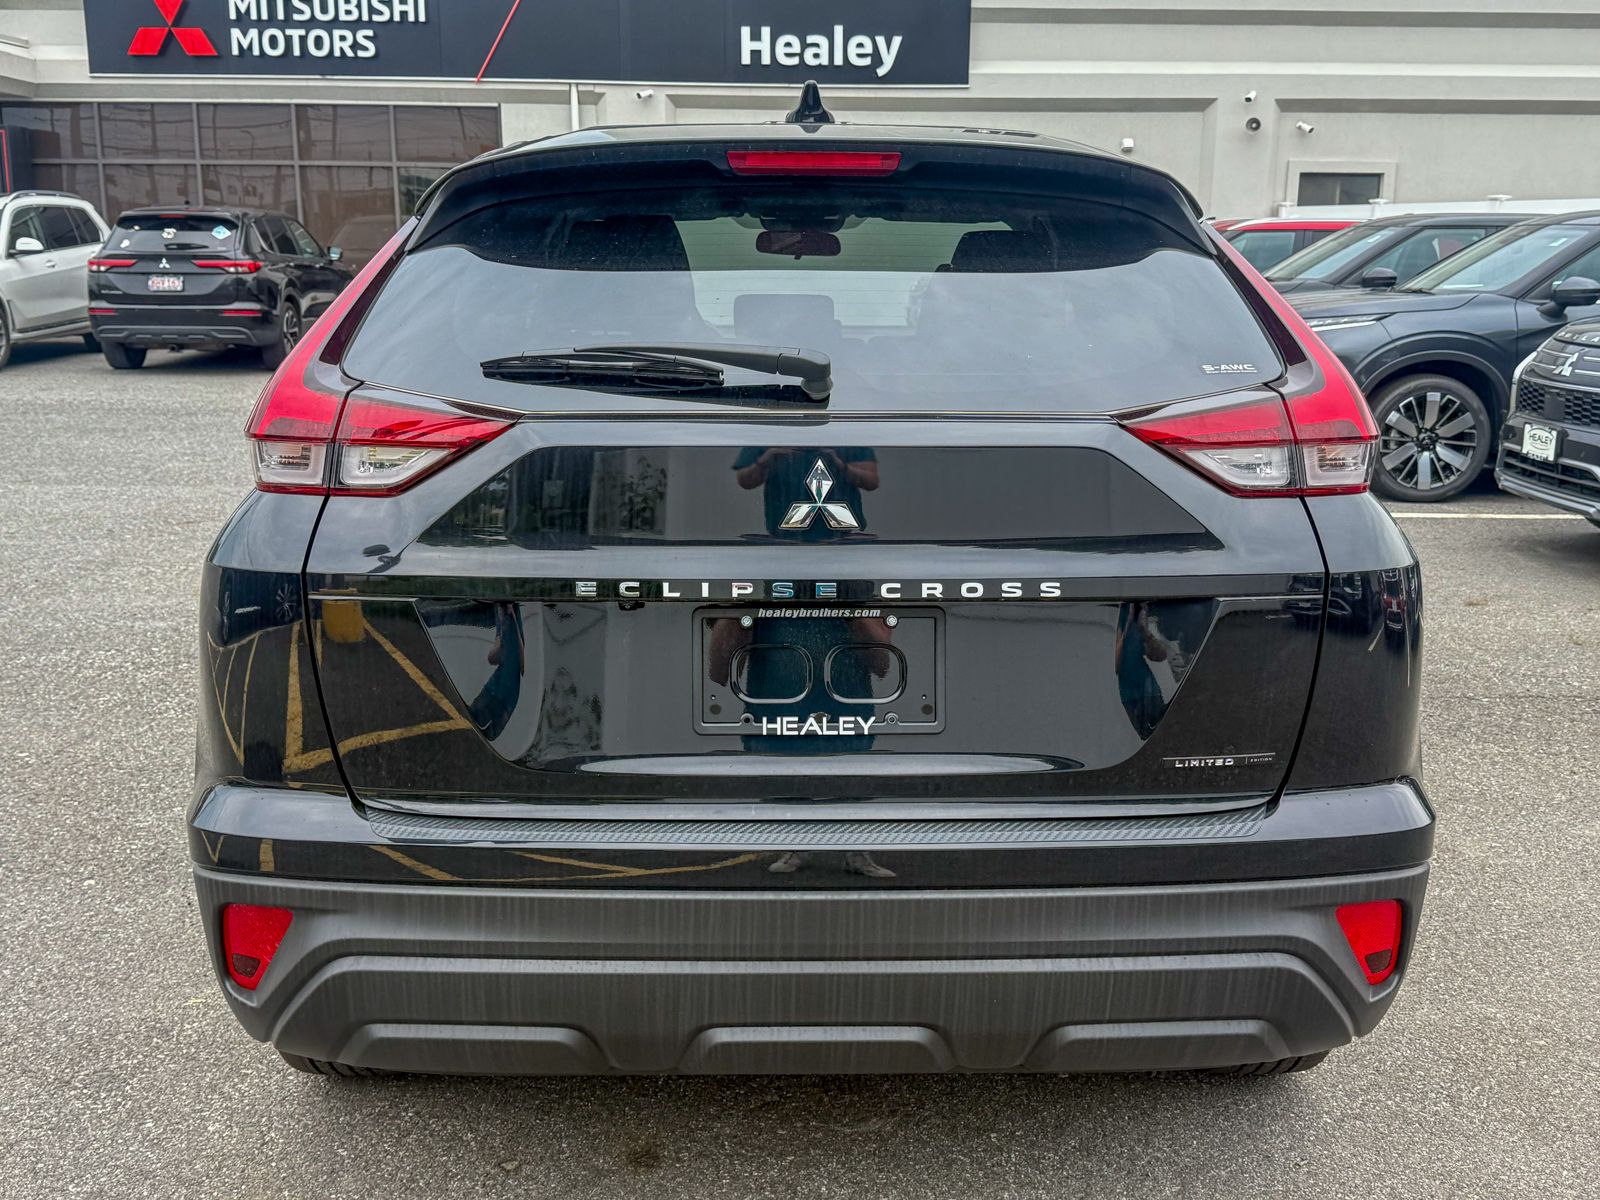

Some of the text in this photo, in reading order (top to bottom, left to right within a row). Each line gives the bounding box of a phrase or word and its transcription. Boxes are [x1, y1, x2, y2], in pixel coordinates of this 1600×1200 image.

[228, 0, 426, 22] MITSUBISHI
[230, 27, 376, 58] MOTORS
[740, 24, 903, 77] Healey
[1201, 363, 1256, 371] S-AWC
[575, 581, 1062, 598] ECLIPSE CROSS
[758, 607, 881, 619] healeybrothers.com
[762, 716, 876, 735] HEALEY
[1174, 758, 1234, 768] LIMITED
